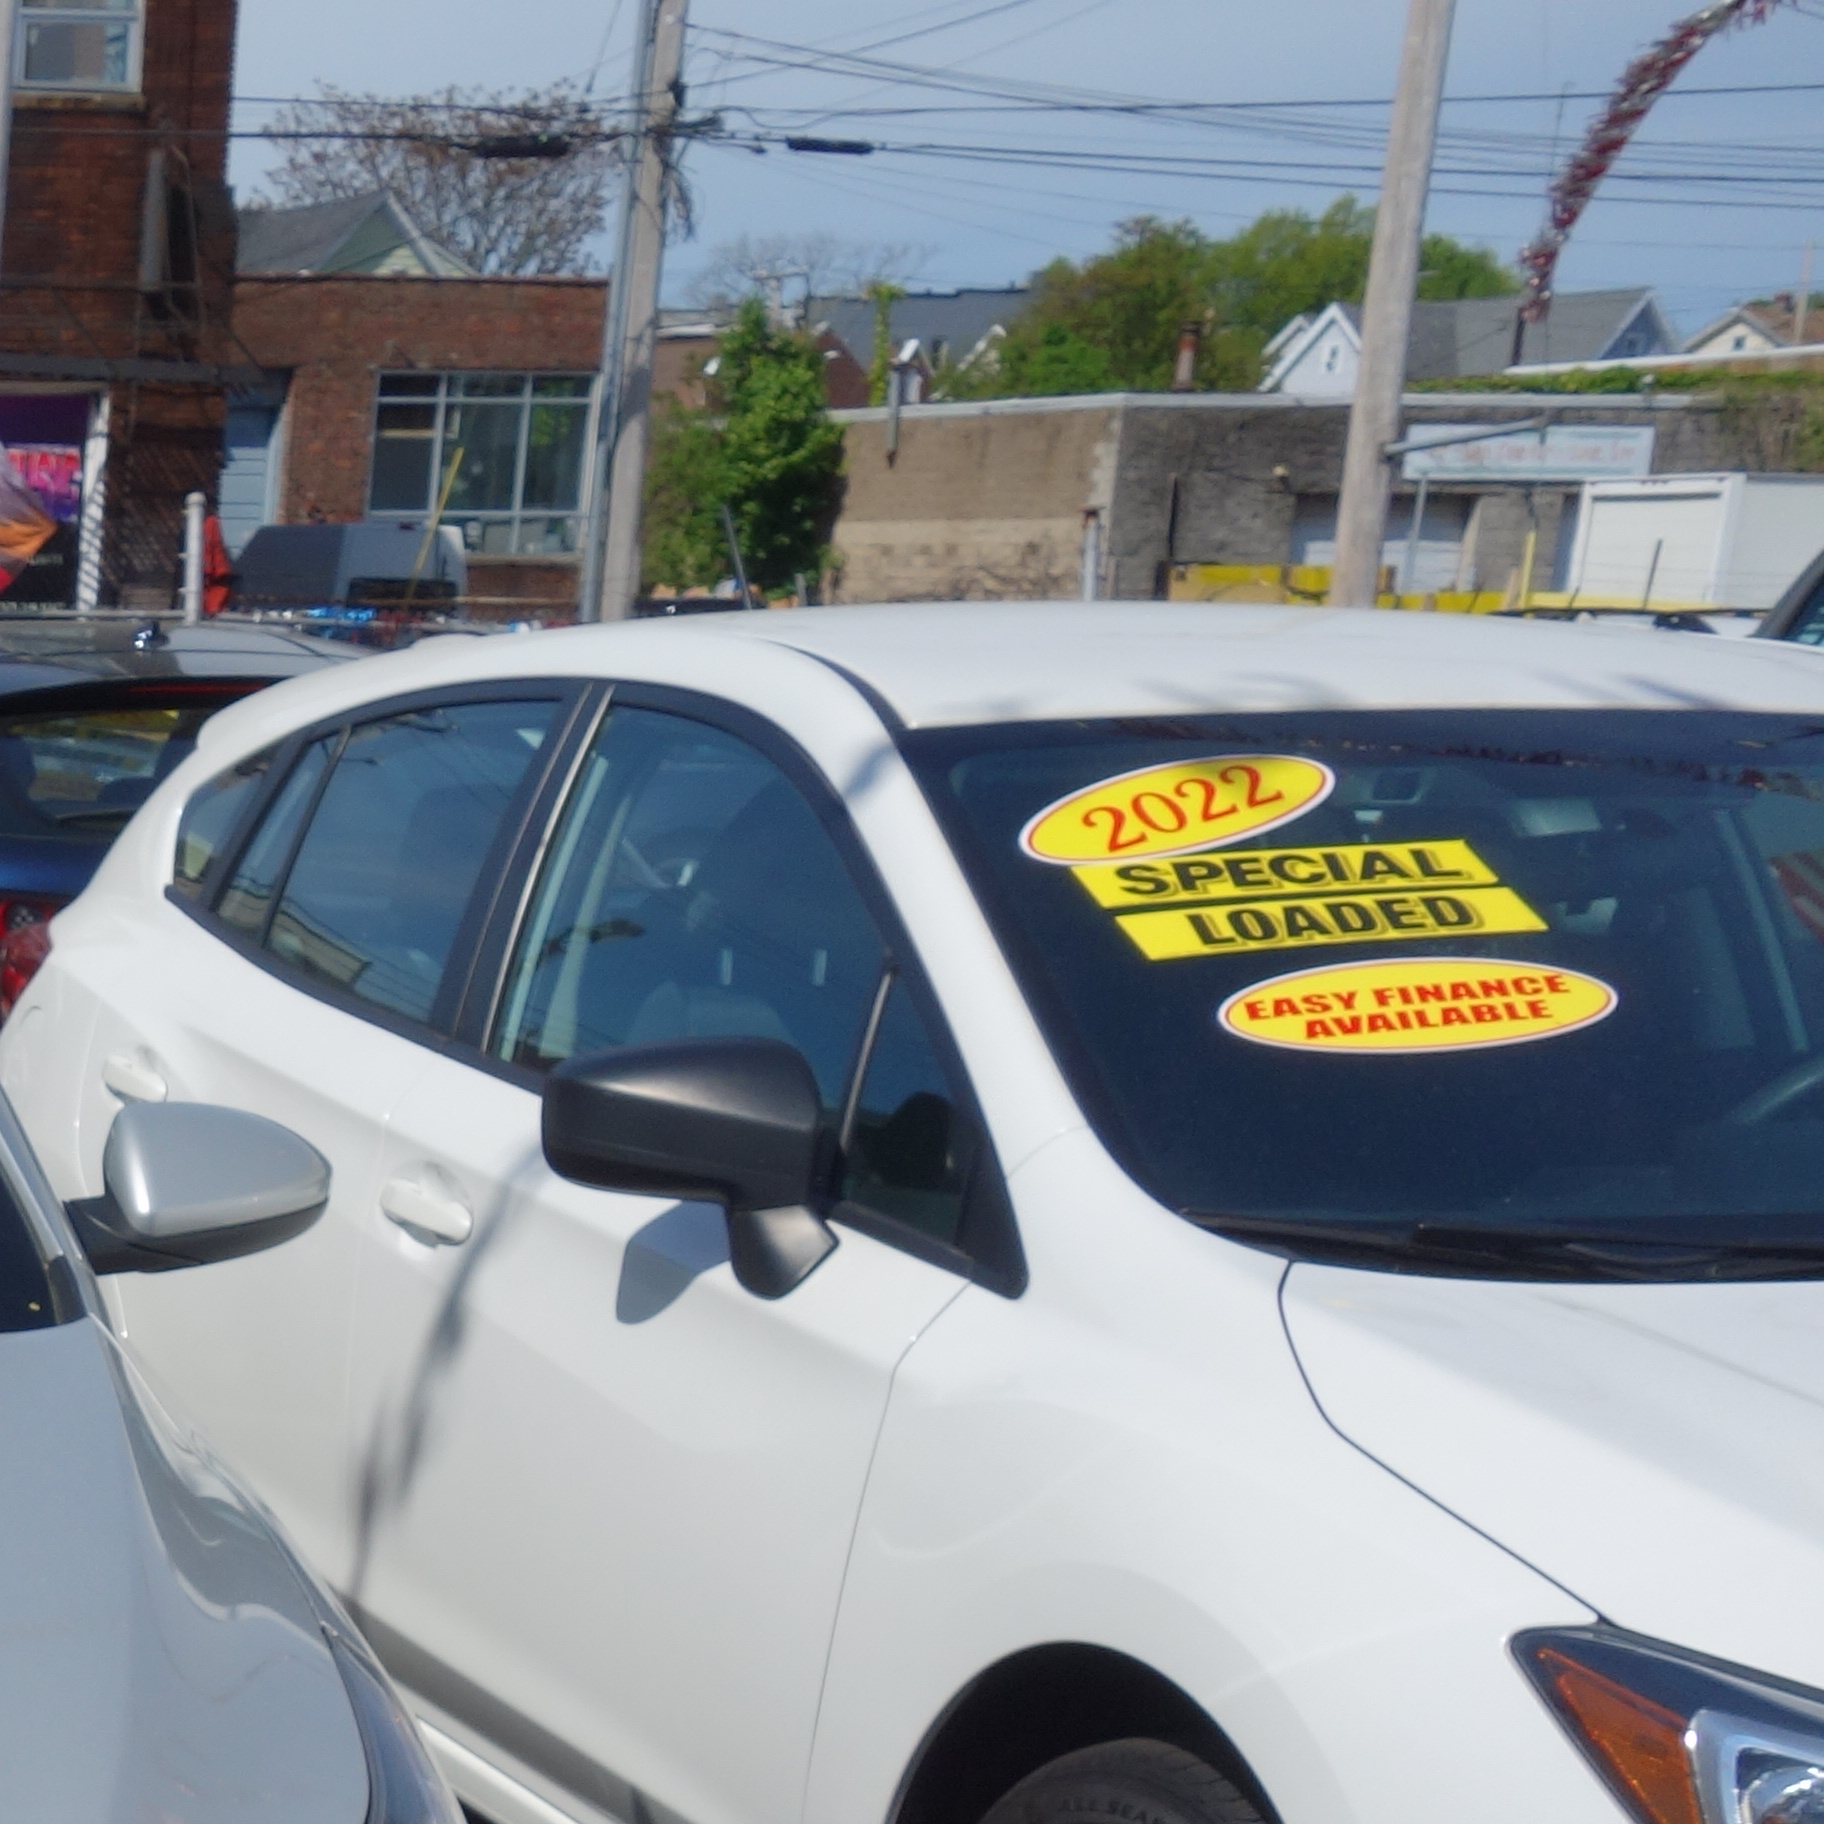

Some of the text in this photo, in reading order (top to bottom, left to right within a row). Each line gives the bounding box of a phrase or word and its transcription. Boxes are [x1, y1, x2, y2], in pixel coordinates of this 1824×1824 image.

[1082, 765, 1284, 853] 2022
[1115, 847, 1464, 900] SPECIAL
[1186, 897, 1485, 950] LOADED
[1244, 974, 1571, 1021] EASY FINANCE
[1303, 1001, 1553, 1040] AVAILABLE
